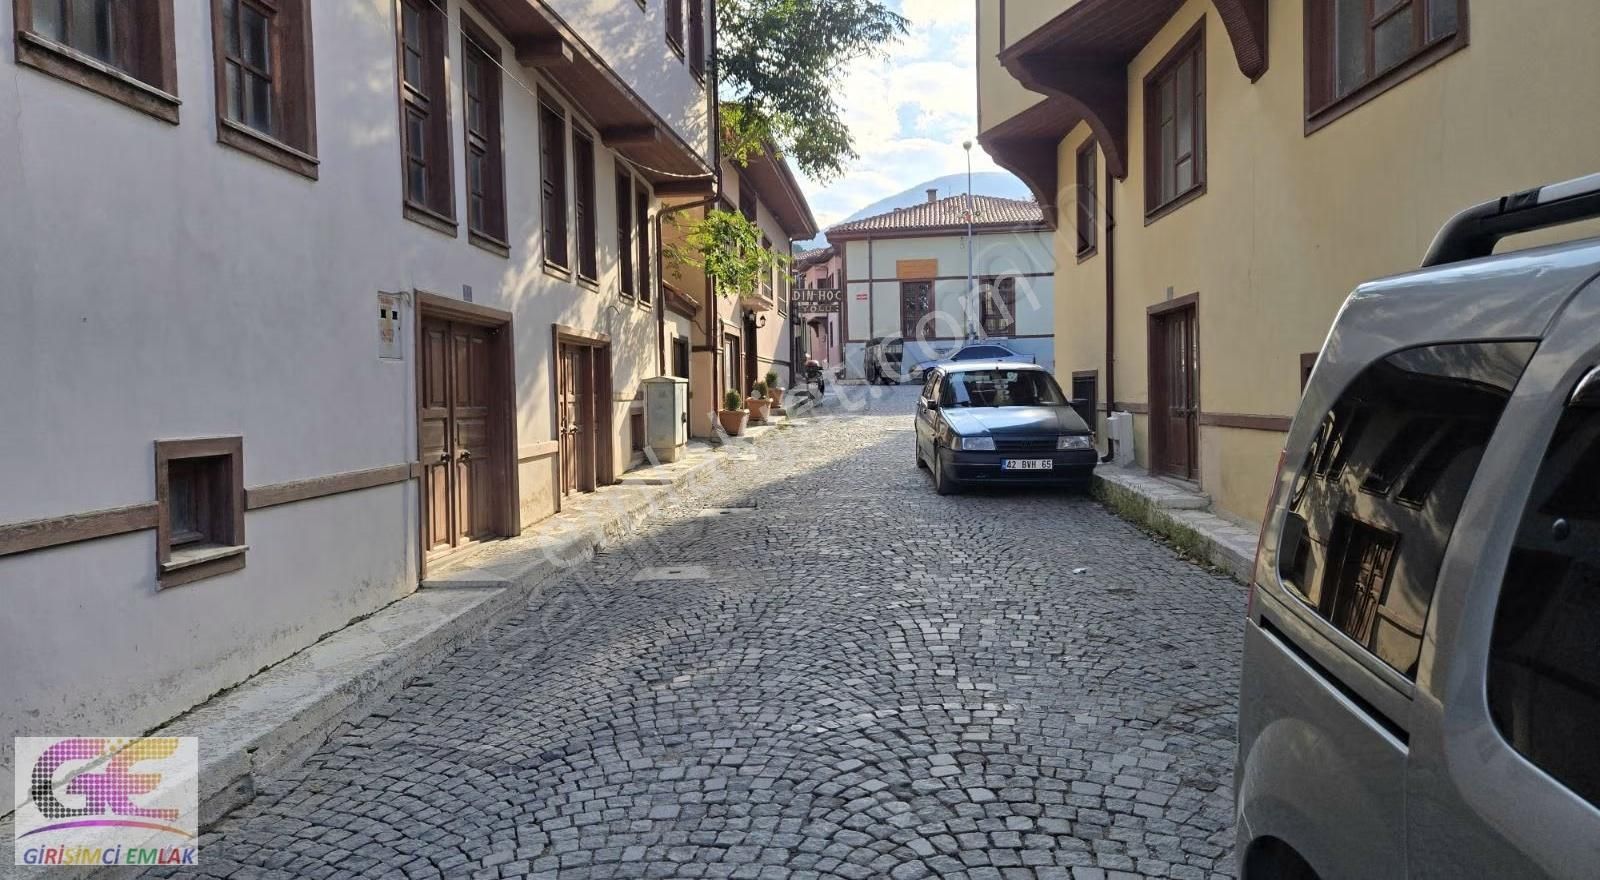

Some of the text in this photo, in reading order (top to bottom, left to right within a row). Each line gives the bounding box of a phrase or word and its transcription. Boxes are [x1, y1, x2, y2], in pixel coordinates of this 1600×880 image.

[1007, 460, 1052, 469] 42 BVH 65
